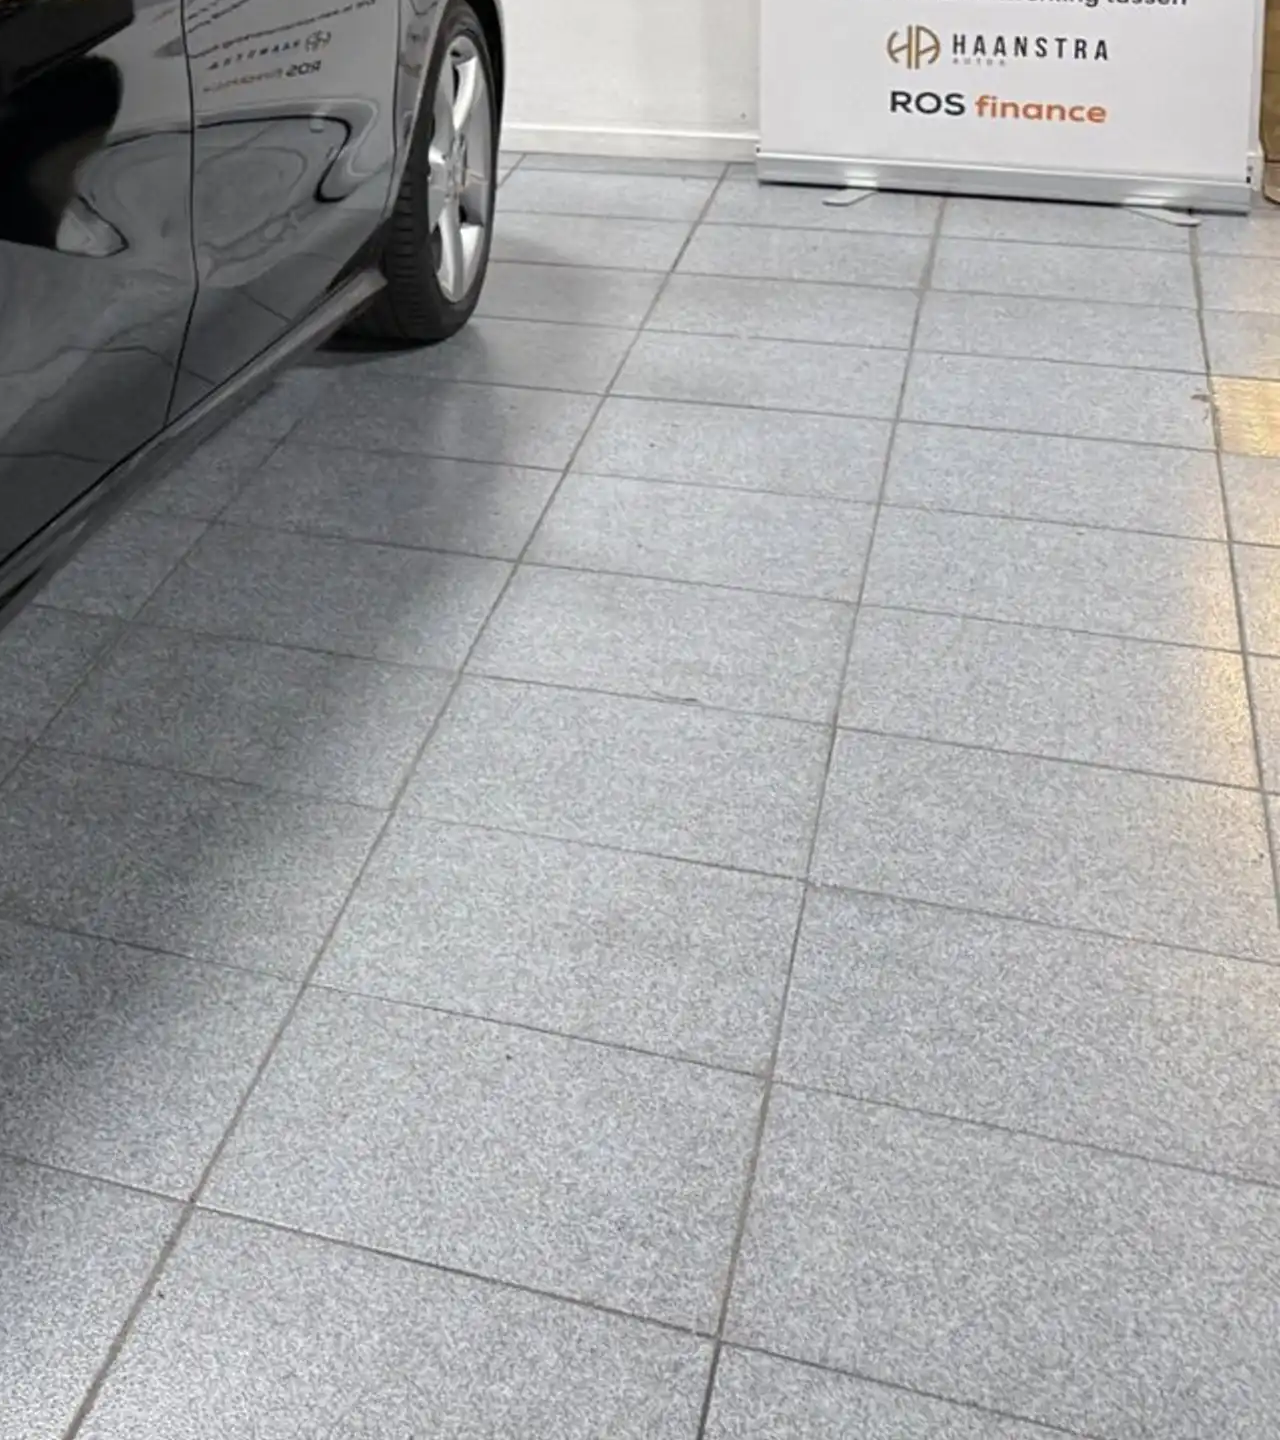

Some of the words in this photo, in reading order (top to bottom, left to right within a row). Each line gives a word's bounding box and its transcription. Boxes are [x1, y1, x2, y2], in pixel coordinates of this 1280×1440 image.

[952, 33, 1109, 61] HAANSTRA
[889, 90, 967, 117] ROS
[973, 95, 1107, 124] finance
